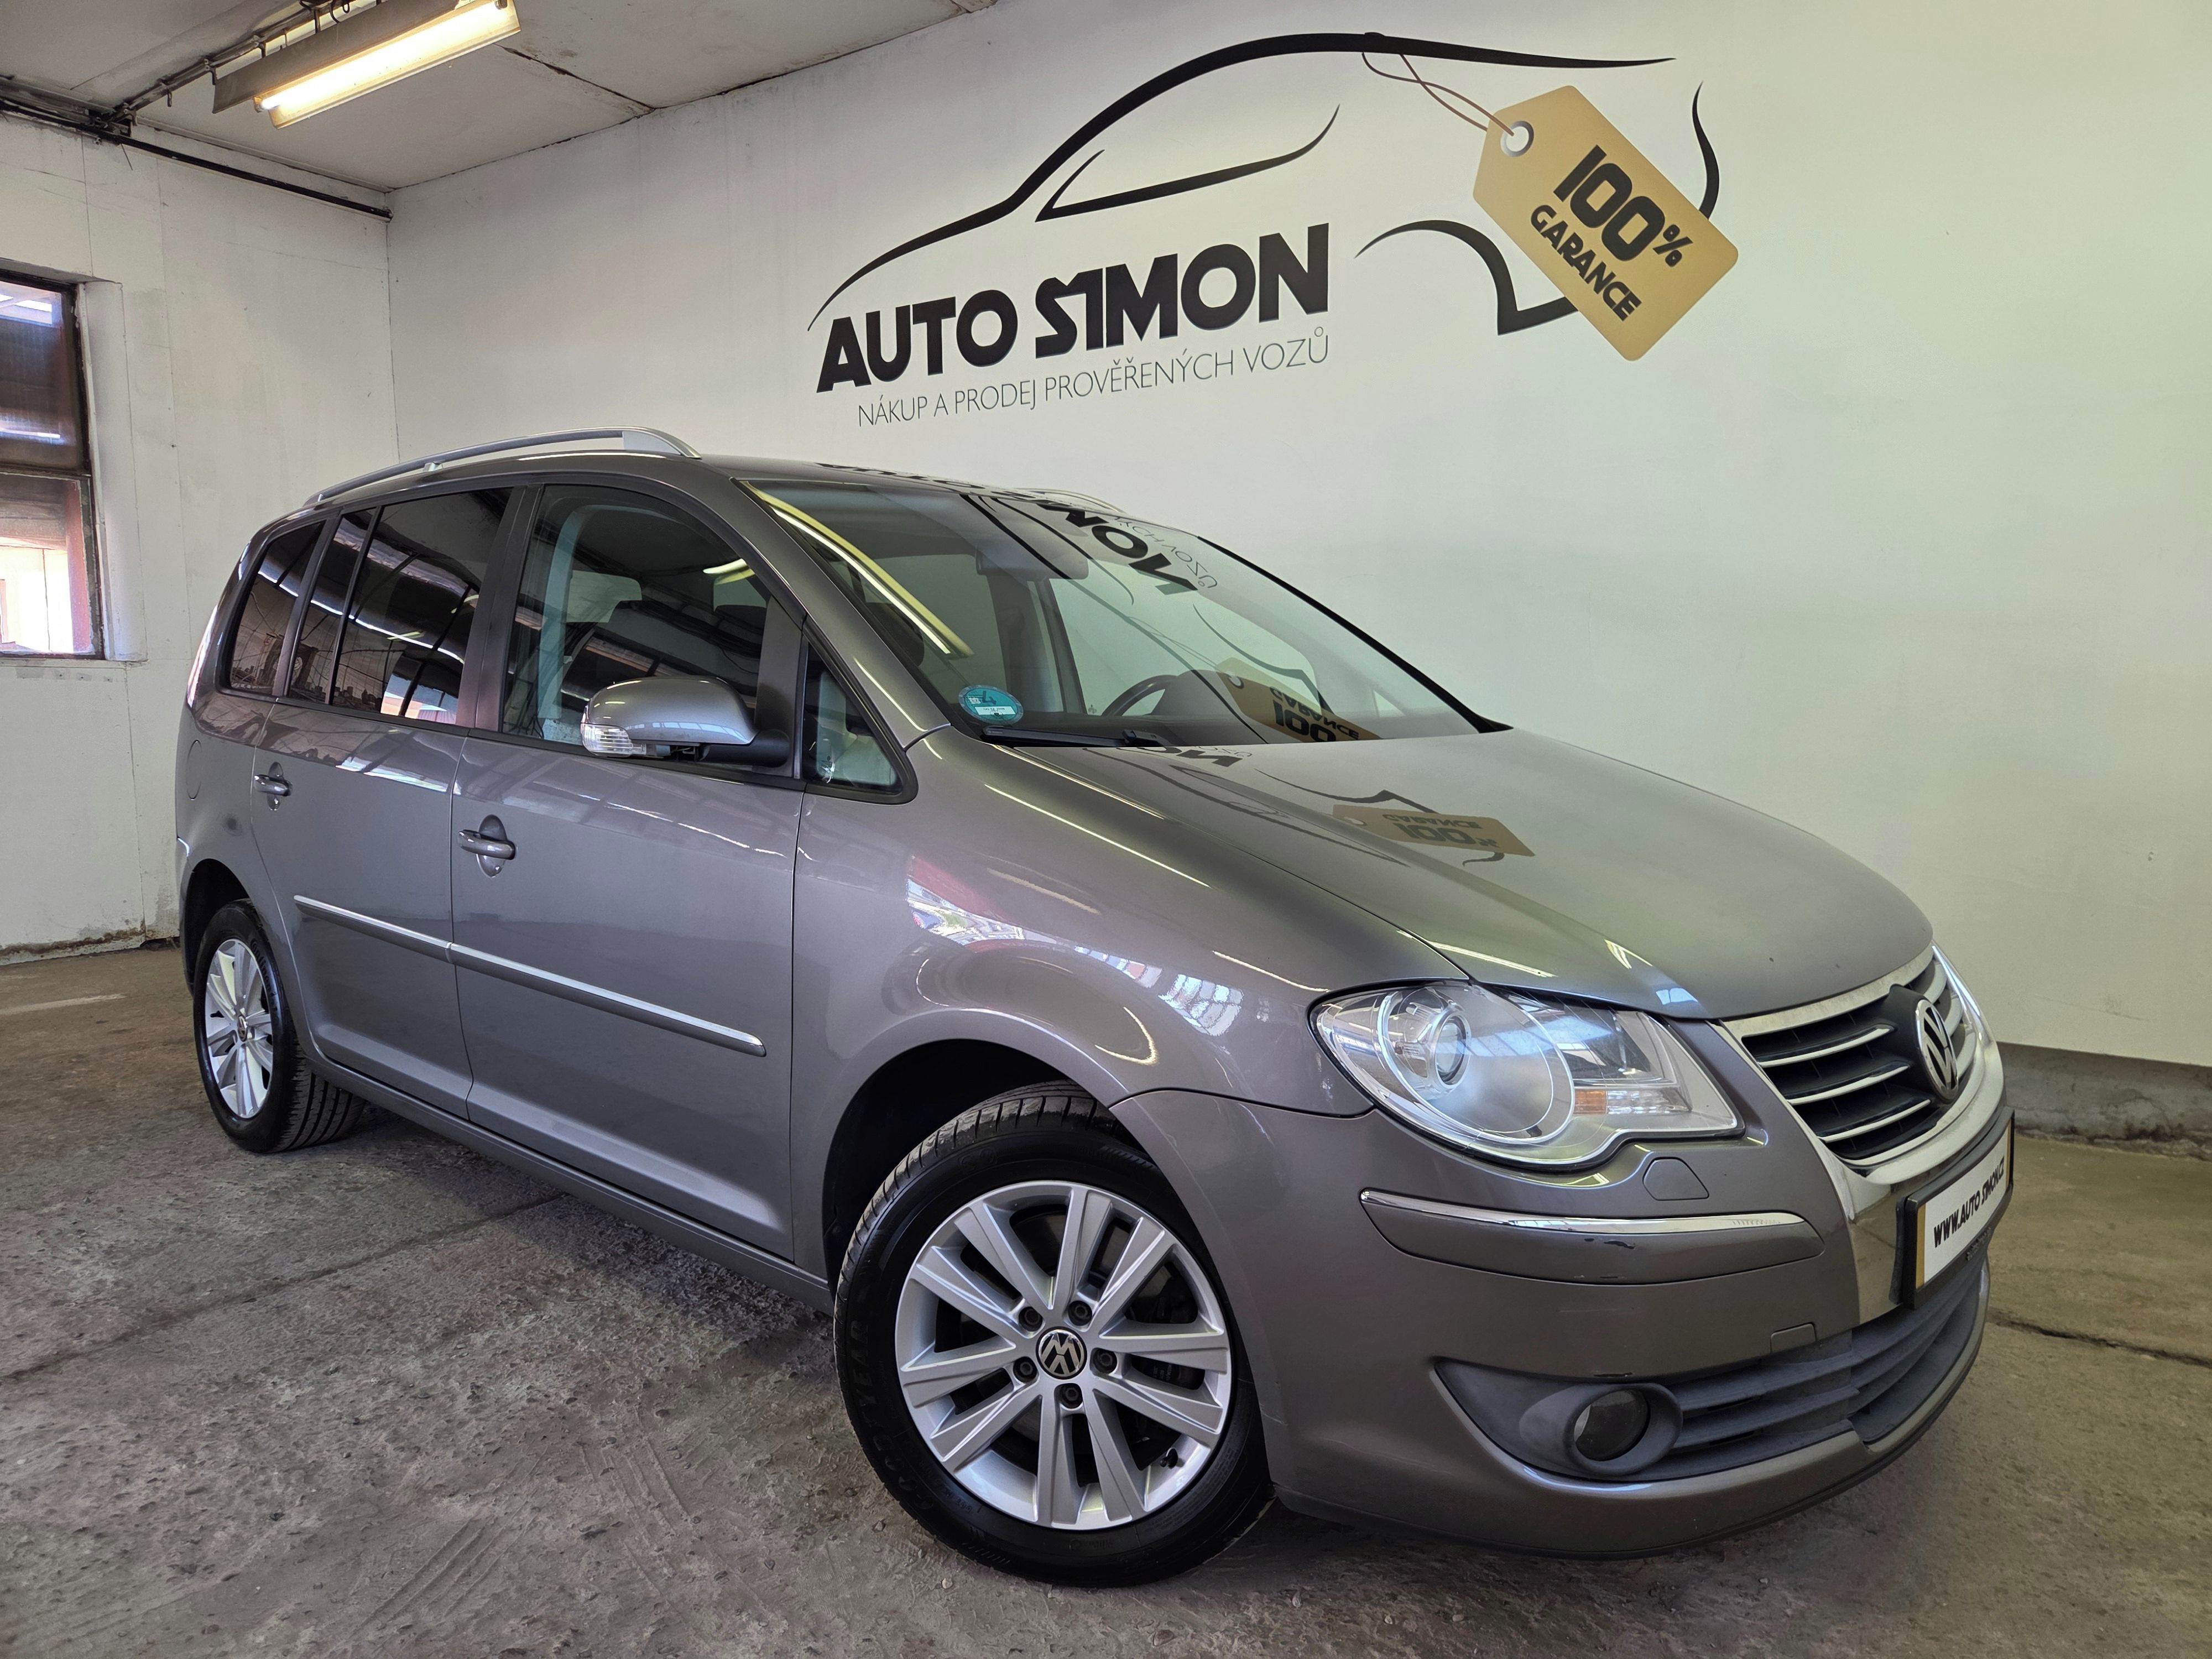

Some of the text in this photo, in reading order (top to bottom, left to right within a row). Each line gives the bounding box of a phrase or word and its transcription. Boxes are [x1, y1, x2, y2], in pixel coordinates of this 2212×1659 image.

[1531, 205, 1642, 321] GARANCE
[1553, 144, 1693, 267] 100%
[816, 222, 1329, 393] AUTO SIMON
[858, 326, 1328, 427] NÁKUP A PRODEJ PROVĚŘENÝCH VOZŮ
